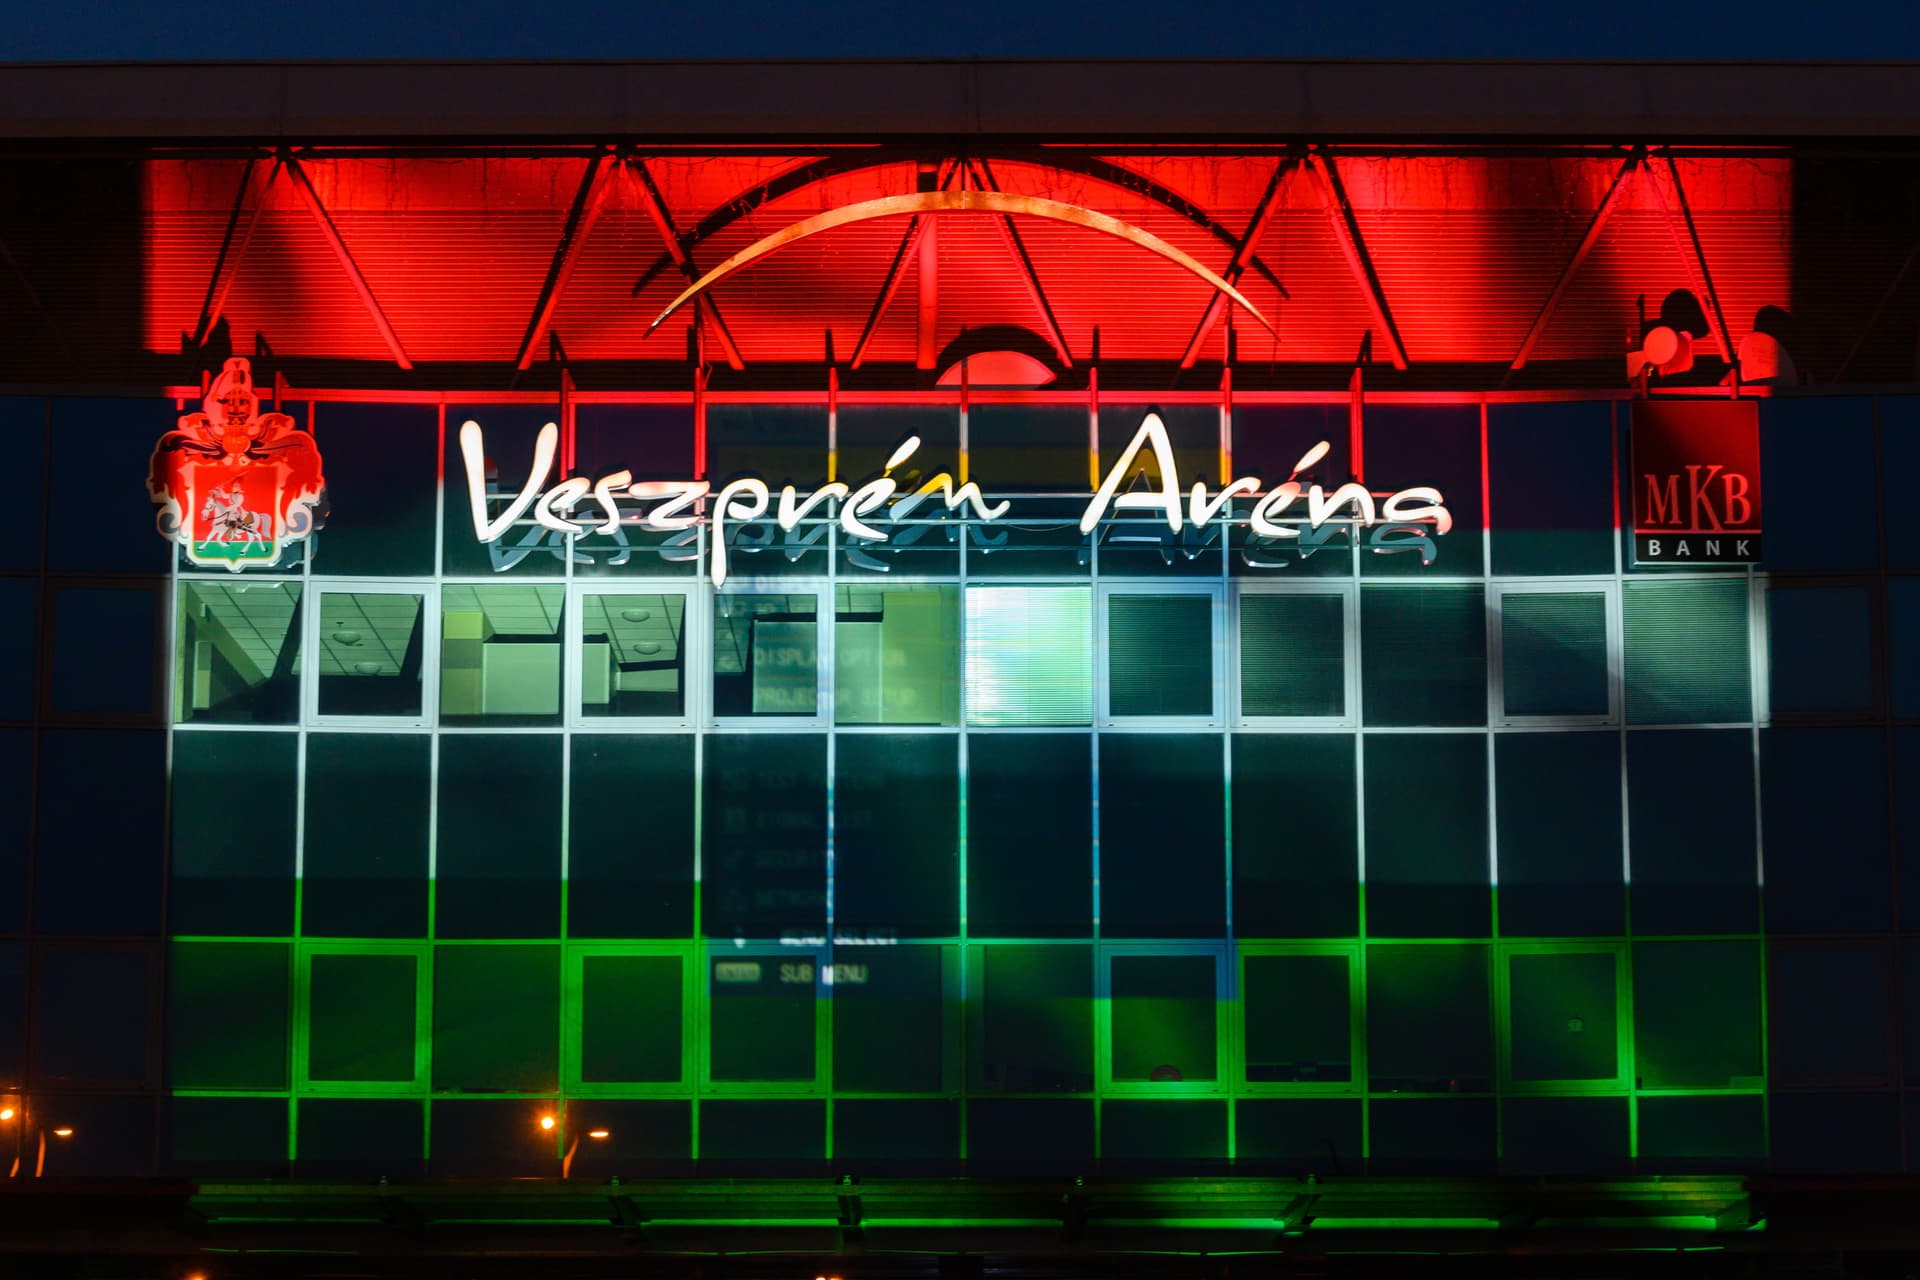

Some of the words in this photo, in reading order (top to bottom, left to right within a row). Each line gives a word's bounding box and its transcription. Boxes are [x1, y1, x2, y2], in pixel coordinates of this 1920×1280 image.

[459, 419, 1011, 589] Veszprém
[1079, 412, 1453, 538] Aréna
[1643, 464, 1751, 533] MKB
[1648, 539, 1751, 556] BANK
[779, 962, 815, 985] SUB
